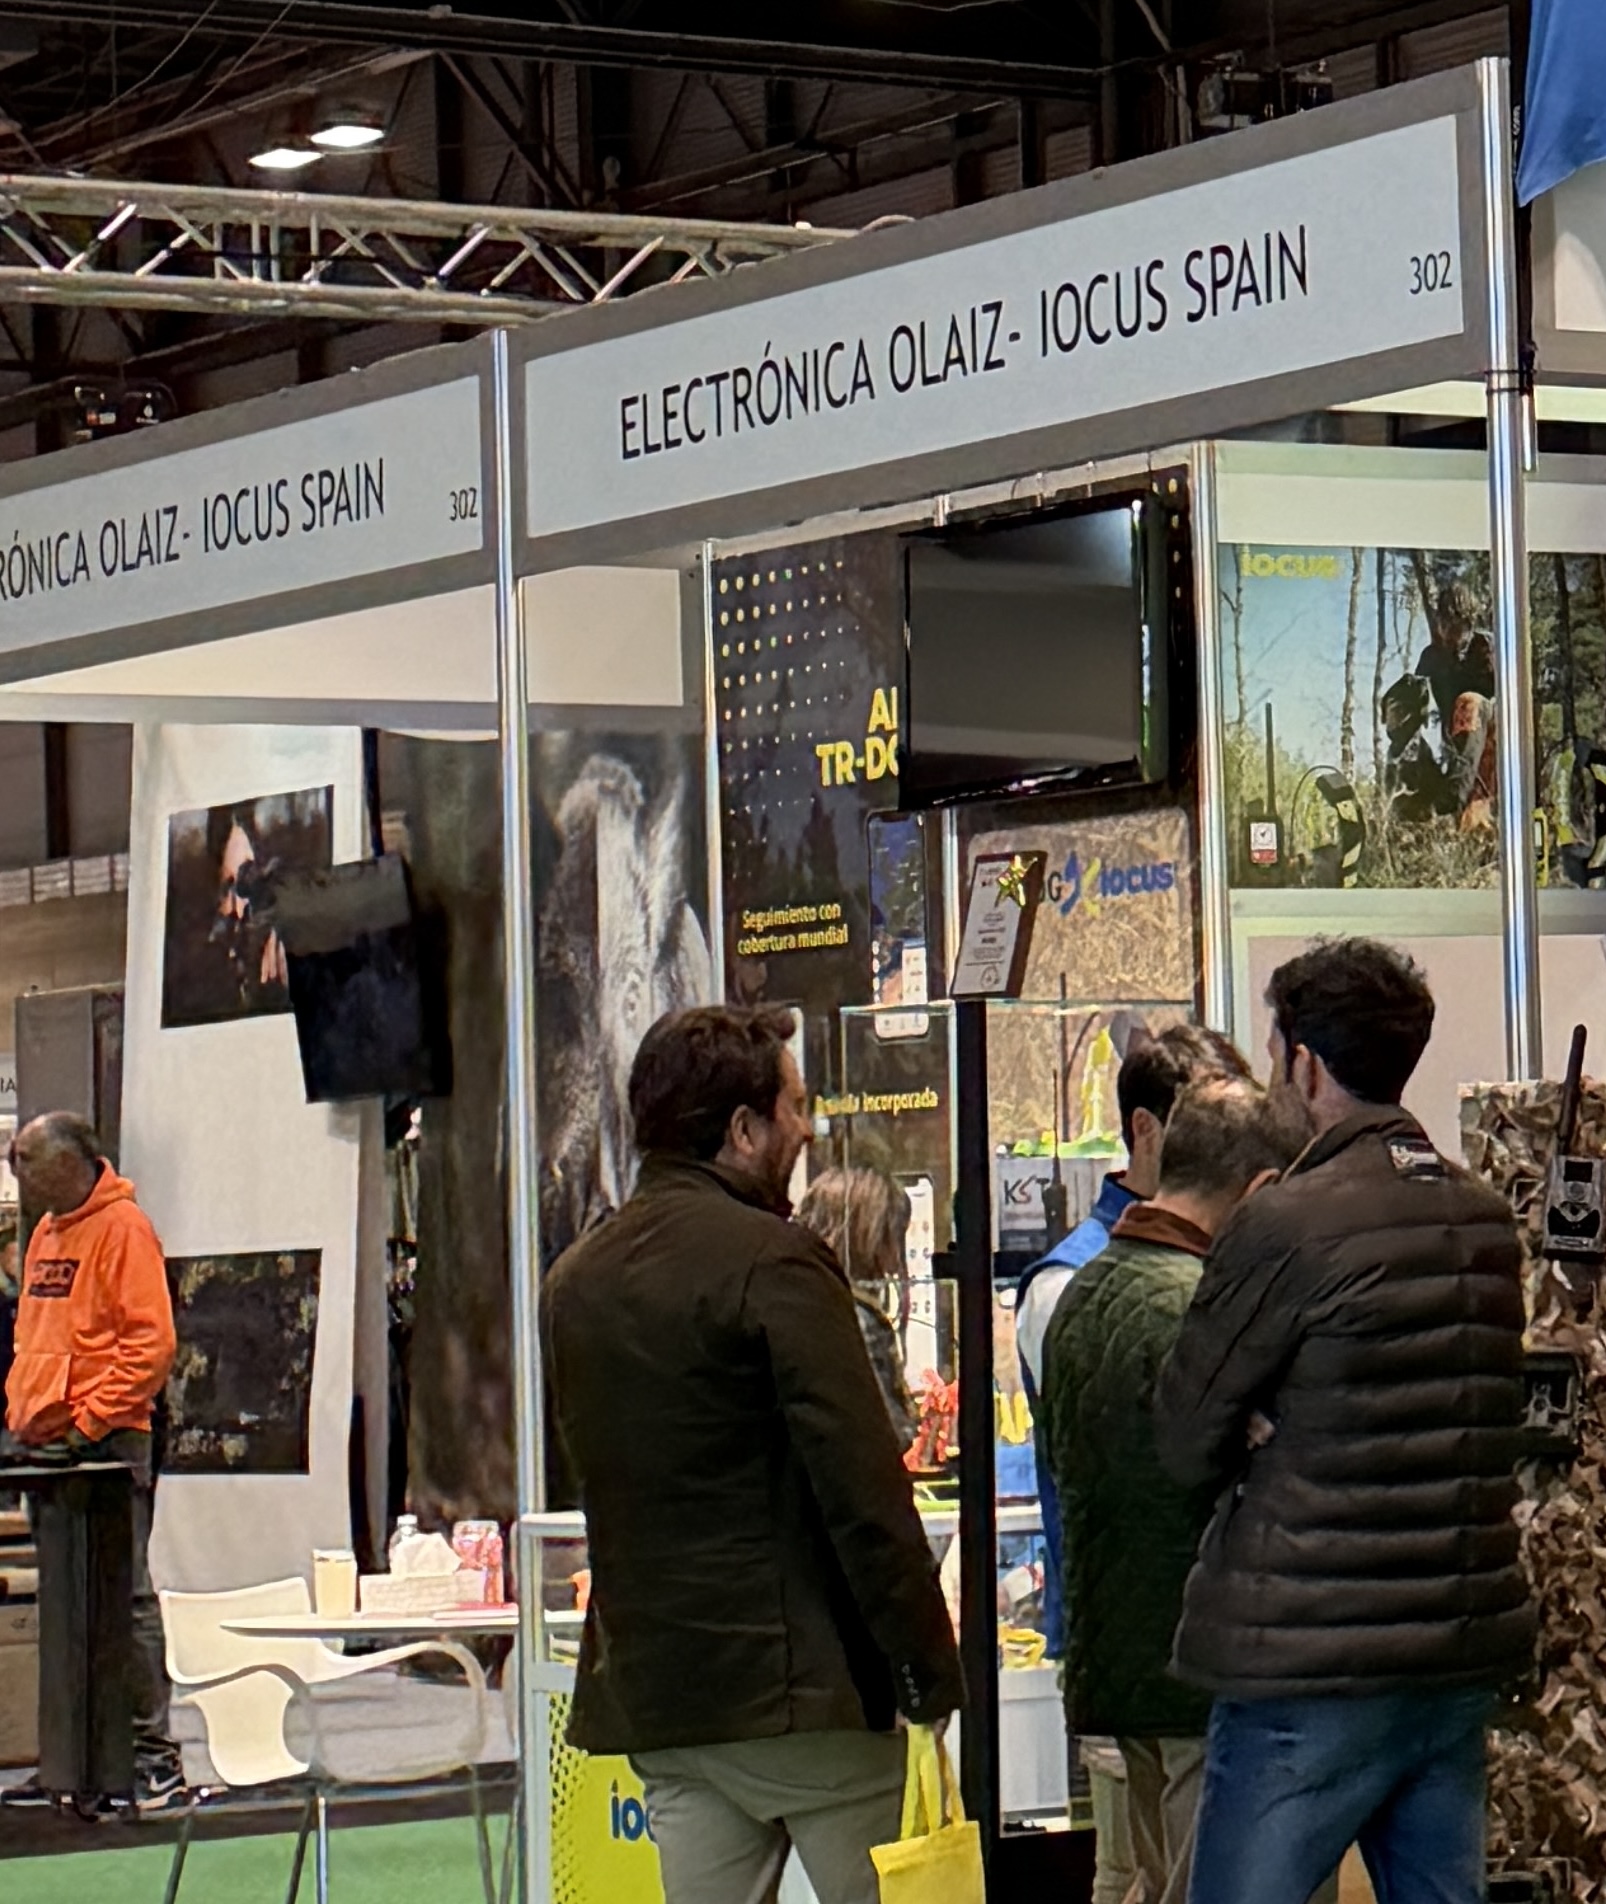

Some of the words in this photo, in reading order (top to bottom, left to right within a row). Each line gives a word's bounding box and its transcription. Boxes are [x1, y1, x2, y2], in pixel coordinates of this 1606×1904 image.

[1408, 251, 1453, 295] 302
[620, 336, 875, 462] ELECTRÓNICA
[1039, 258, 1168, 358] IOCUS
[1183, 223, 1309, 325] SPAIN
[203, 478, 290, 553] IOCUS
[301, 457, 385, 532] SPAIN
[448, 487, 478, 522] 302
